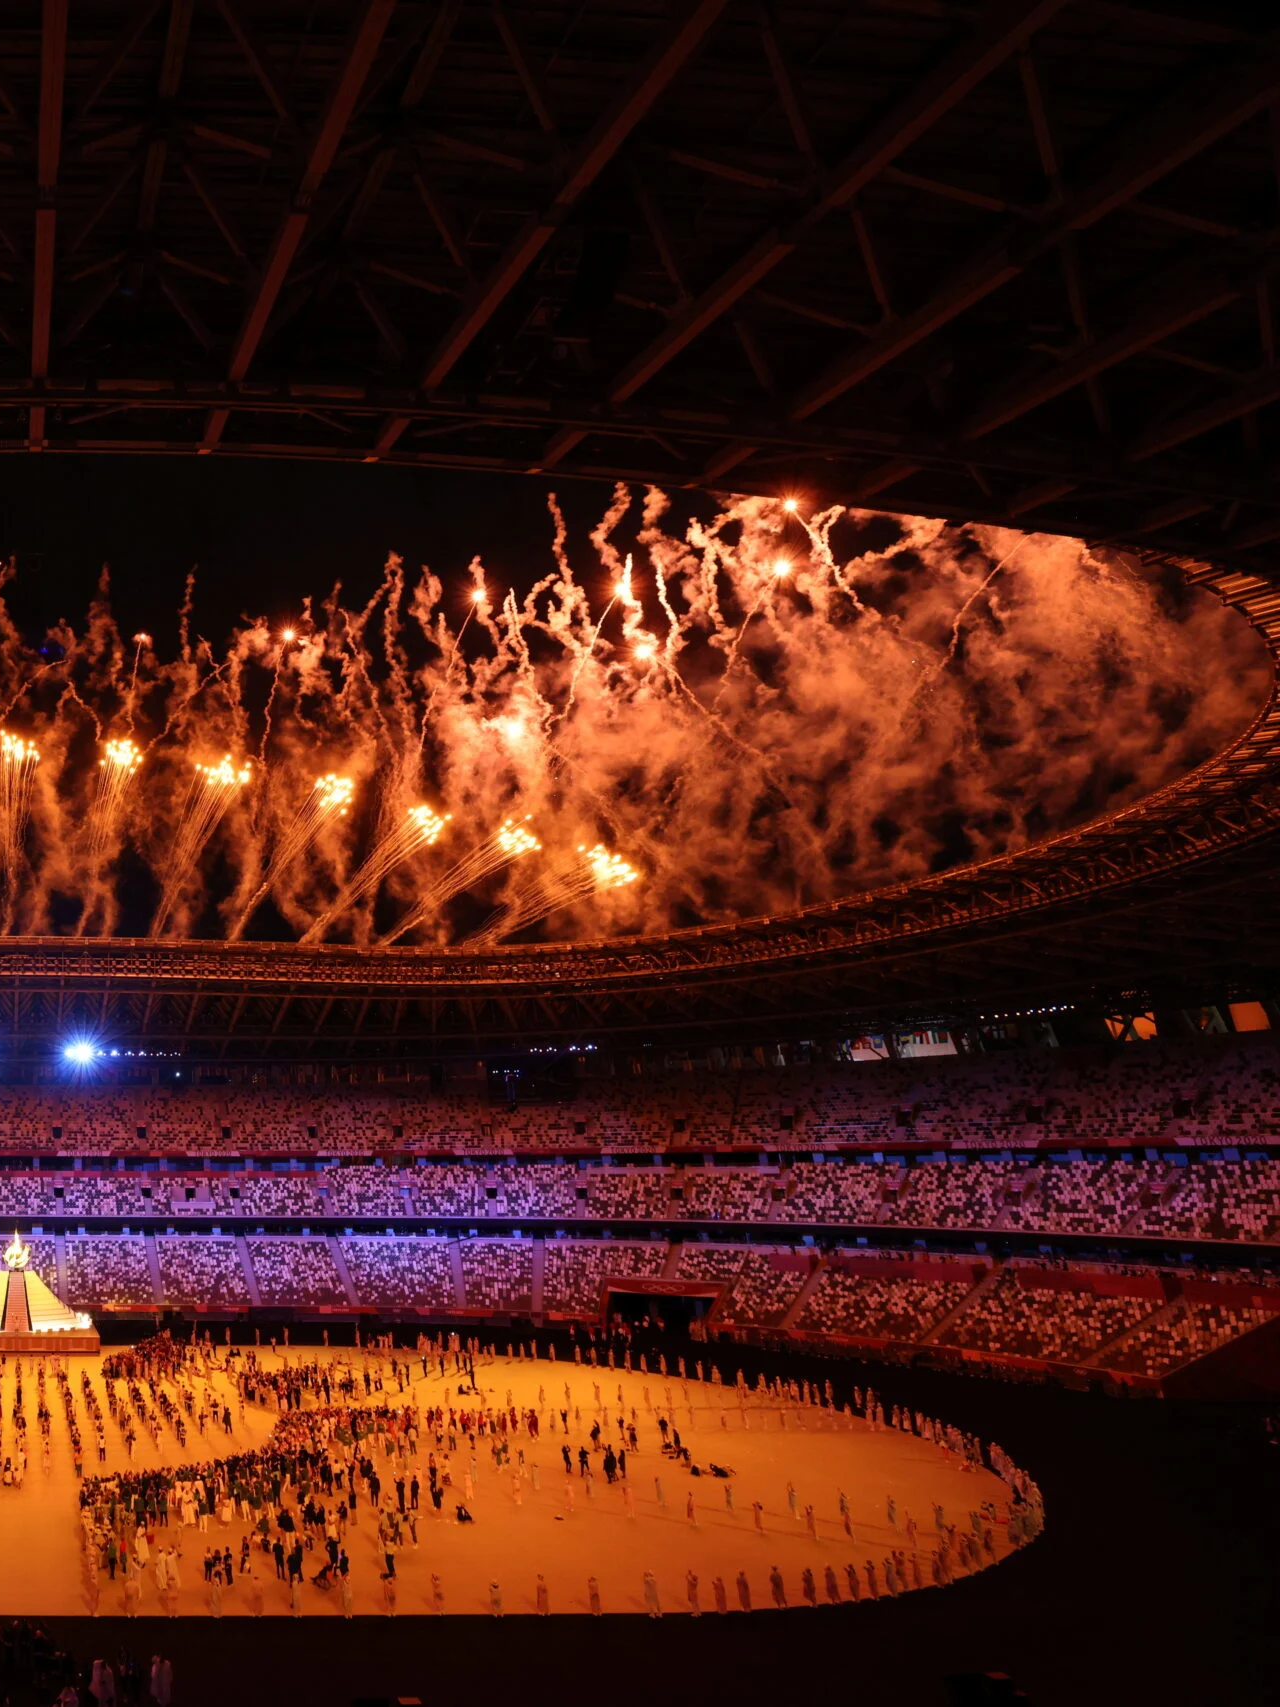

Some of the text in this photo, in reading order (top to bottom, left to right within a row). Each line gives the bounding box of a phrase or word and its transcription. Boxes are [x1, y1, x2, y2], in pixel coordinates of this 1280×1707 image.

[964, 1139, 1025, 1149] TOKYO 2020
[1192, 1135, 1267, 1146] TOKYO 2020
[776, 1143, 825, 1152] TOKYO 2020
